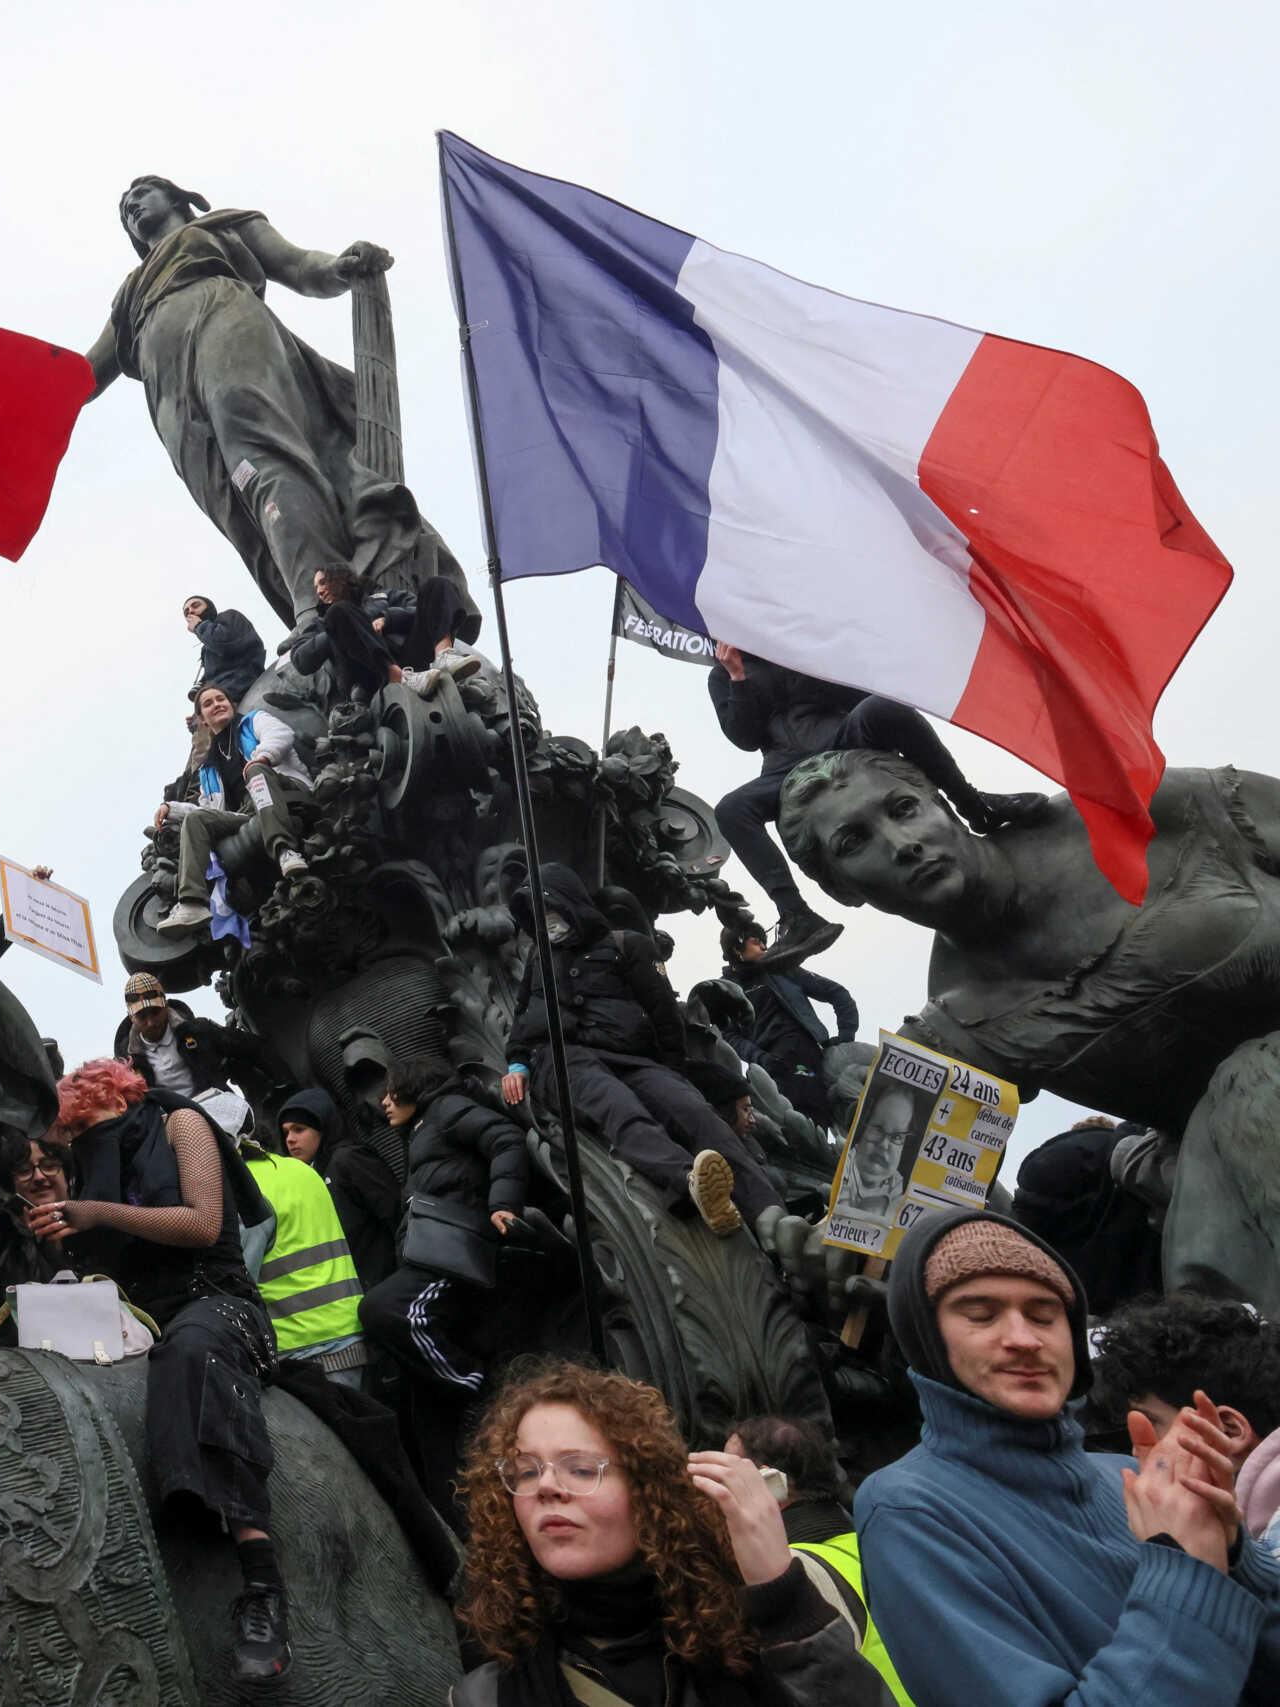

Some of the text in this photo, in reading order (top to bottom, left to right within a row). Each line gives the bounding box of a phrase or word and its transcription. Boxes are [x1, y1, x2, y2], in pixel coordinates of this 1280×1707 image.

[882, 1052, 943, 1091] ECOLES
[949, 1064, 1000, 1105] 24 ans
[976, 1107, 1013, 1130] début de
[970, 1127, 1003, 1147] carrière
[923, 1135, 976, 1172] 43 ans
[944, 1173, 985, 1198] cotisations
[899, 1203, 924, 1229] 67
[871, 1230, 881, 1246] ?
